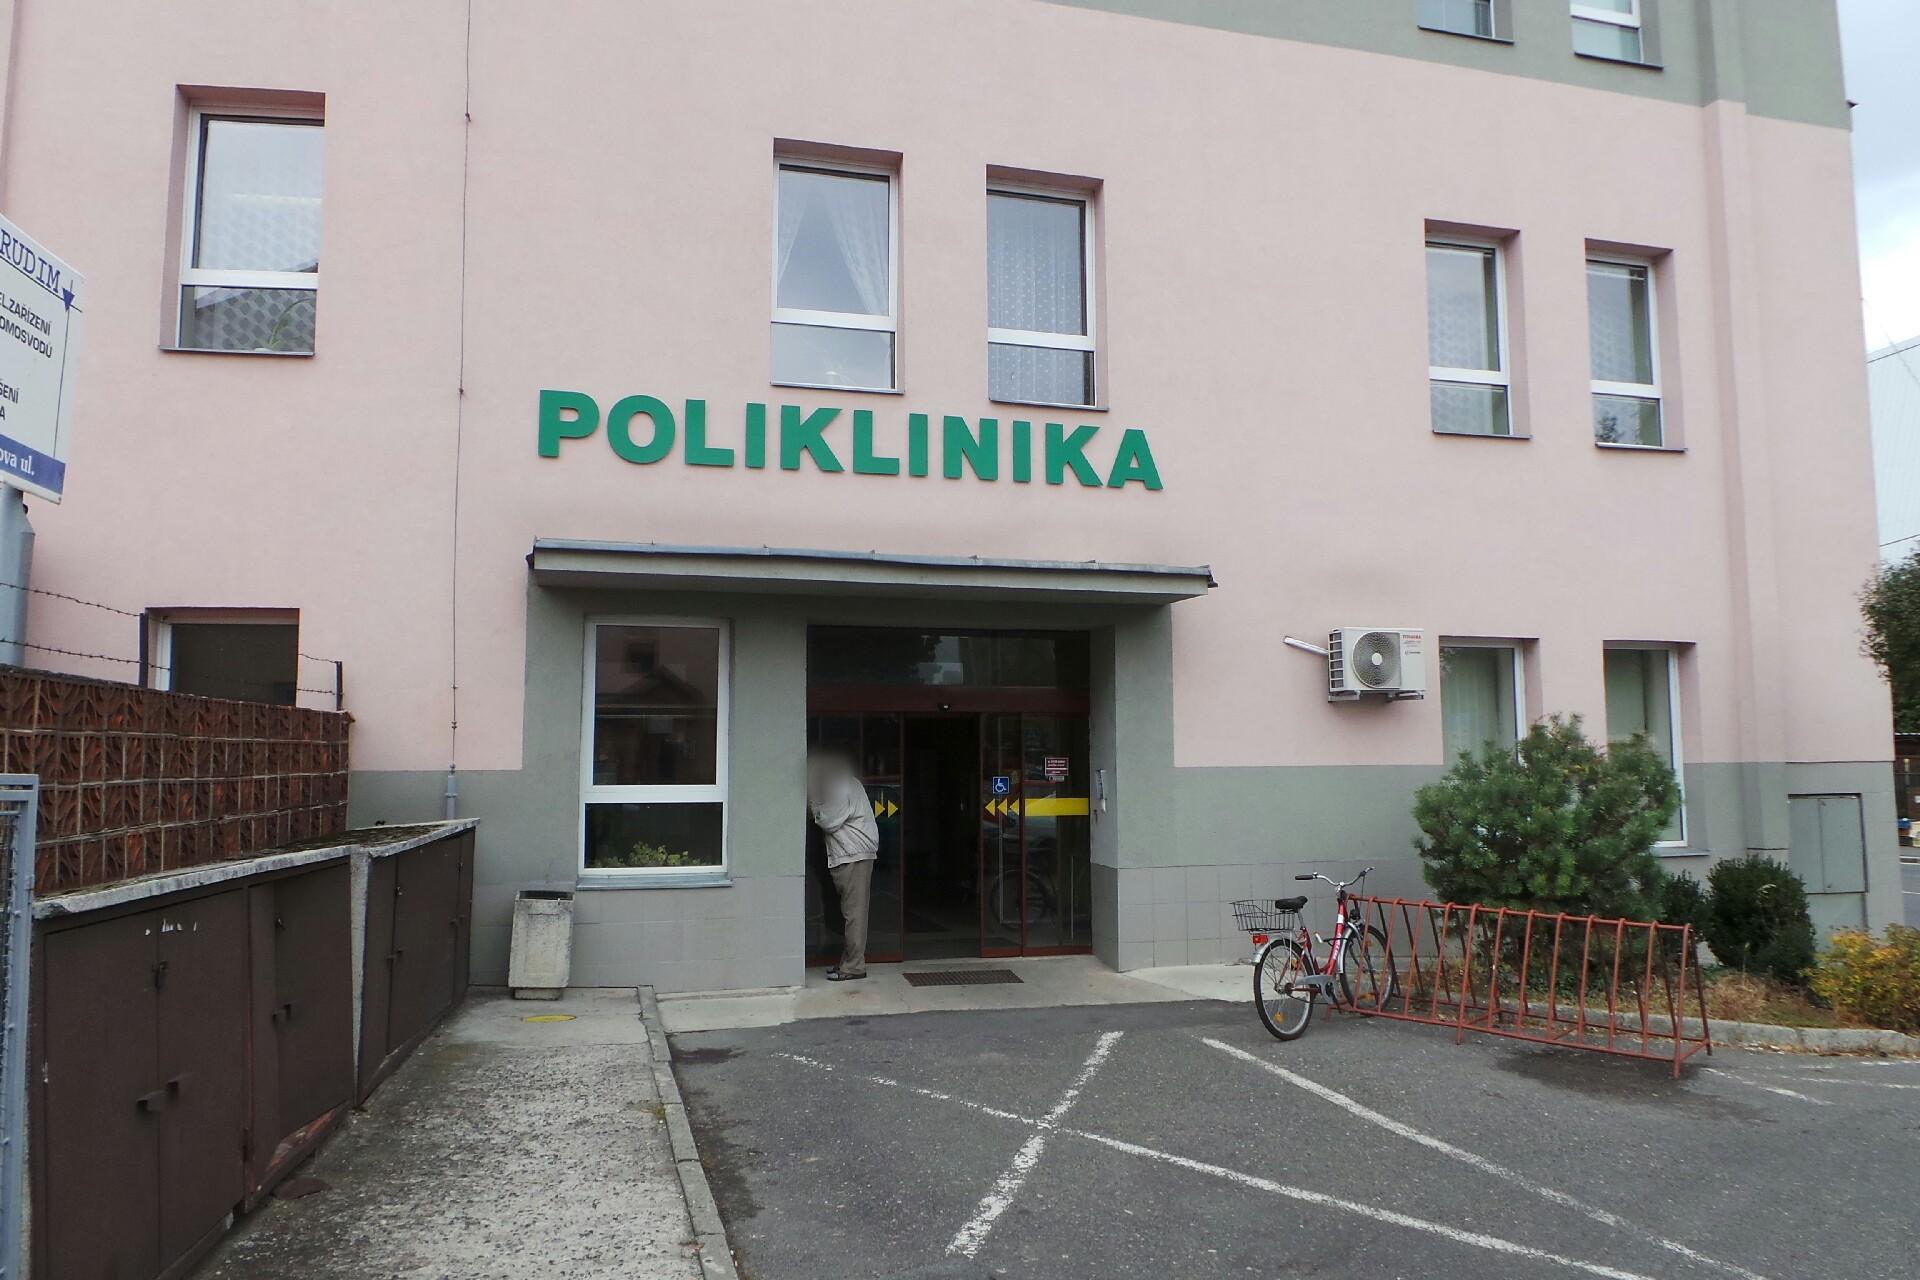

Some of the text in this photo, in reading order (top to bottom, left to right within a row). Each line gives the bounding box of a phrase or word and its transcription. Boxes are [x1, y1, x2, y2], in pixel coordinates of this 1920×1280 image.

[0, 228, 61, 294] RUDIM
[20, 455, 35, 476] ul.
[538, 388, 1164, 490] POLIKLINIKA
